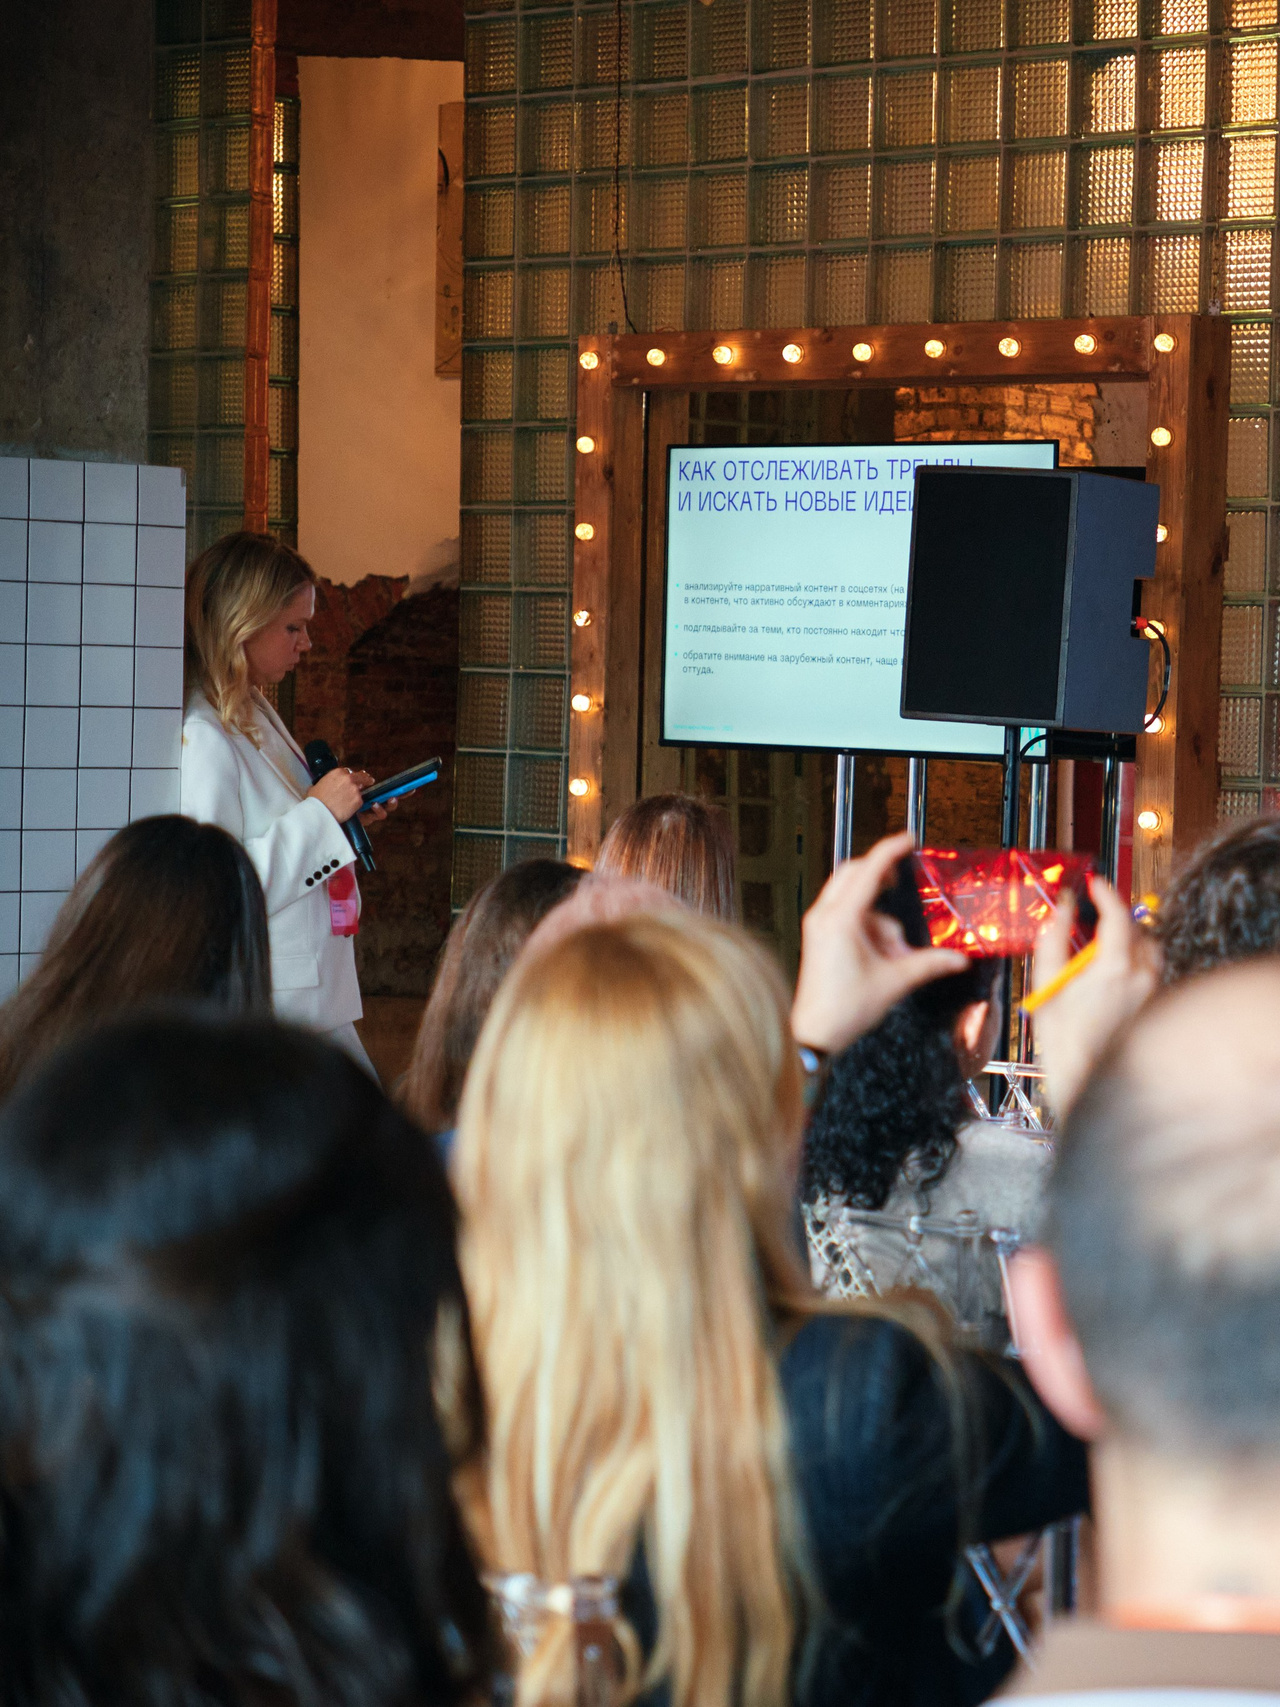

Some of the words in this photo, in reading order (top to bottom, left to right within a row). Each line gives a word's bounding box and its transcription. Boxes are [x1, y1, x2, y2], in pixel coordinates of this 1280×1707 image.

[678, 460, 717, 482] КАК
[723, 459, 879, 482] ОТСЛЕЖИВАТЬ
[678, 491, 692, 512] И
[698, 490, 778, 512] ИСКАТЬ
[784, 490, 857, 512] НОВЫЕ
[684, 581, 743, 594] анализируйте
[744, 582, 802, 594] нарративный
[803, 584, 839, 593] контент
[840, 585, 846, 593] в
[847, 585, 888, 594] соцсетях
[683, 596, 690, 605] в
[691, 596, 731, 606] контенте,
[733, 597, 749, 606] что
[750, 597, 785, 606] активно
[786, 595, 837, 609] обсуждают
[838, 599, 844, 608] в
[683, 623, 747, 634] подглядывайте
[748, 625, 759, 634] за
[761, 625, 784, 635] теми,
[786, 626, 802, 635] кто
[803, 626, 849, 636] постоянно
[850, 628, 888, 638] находит
[682, 649, 723, 662] обратите
[724, 653, 766, 662] внимание
[767, 654, 778, 662] на
[779, 652, 834, 665] зарубежный
[836, 656, 873, 666] контент,
[875, 657, 898, 667] чаще
[682, 665, 714, 676] оттуда.
